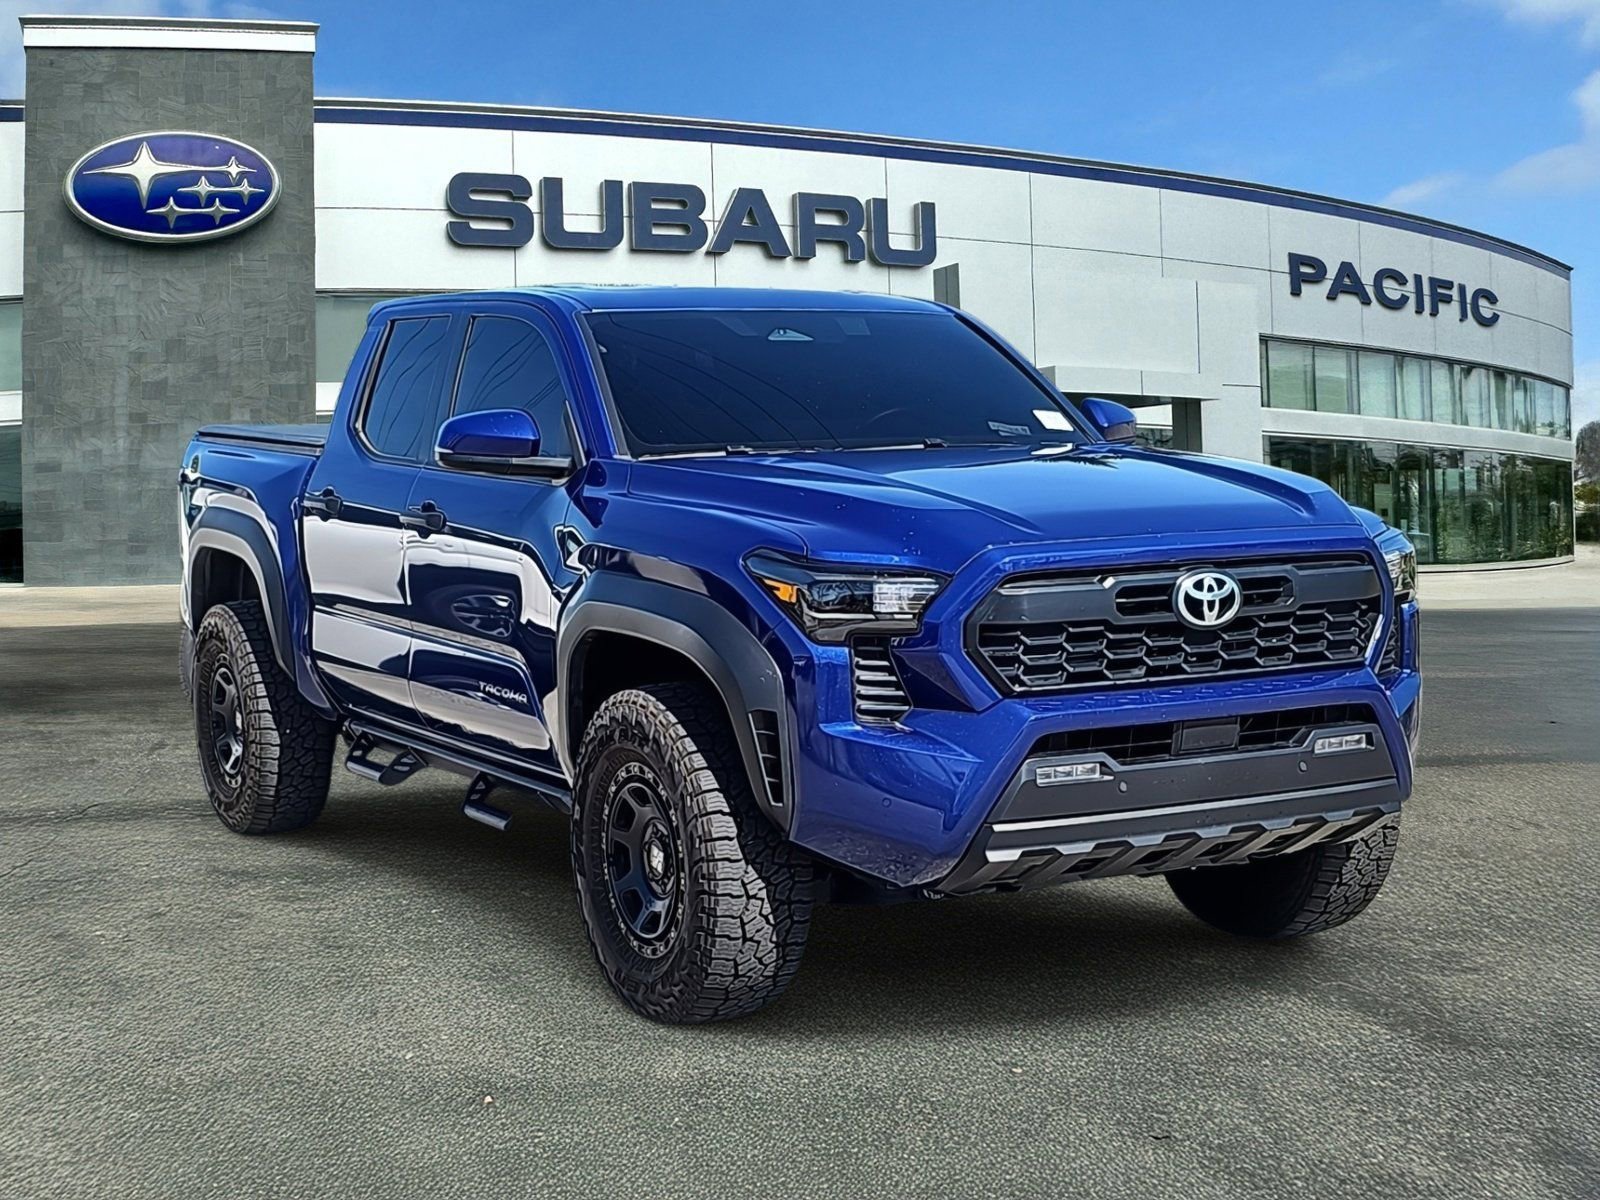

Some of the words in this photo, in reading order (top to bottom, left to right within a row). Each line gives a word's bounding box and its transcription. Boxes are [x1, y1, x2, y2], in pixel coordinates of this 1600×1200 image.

[446, 171, 936, 267] SUBARU
[1288, 252, 1500, 327] PACIFIC
[478, 681, 528, 703] TACOMA
